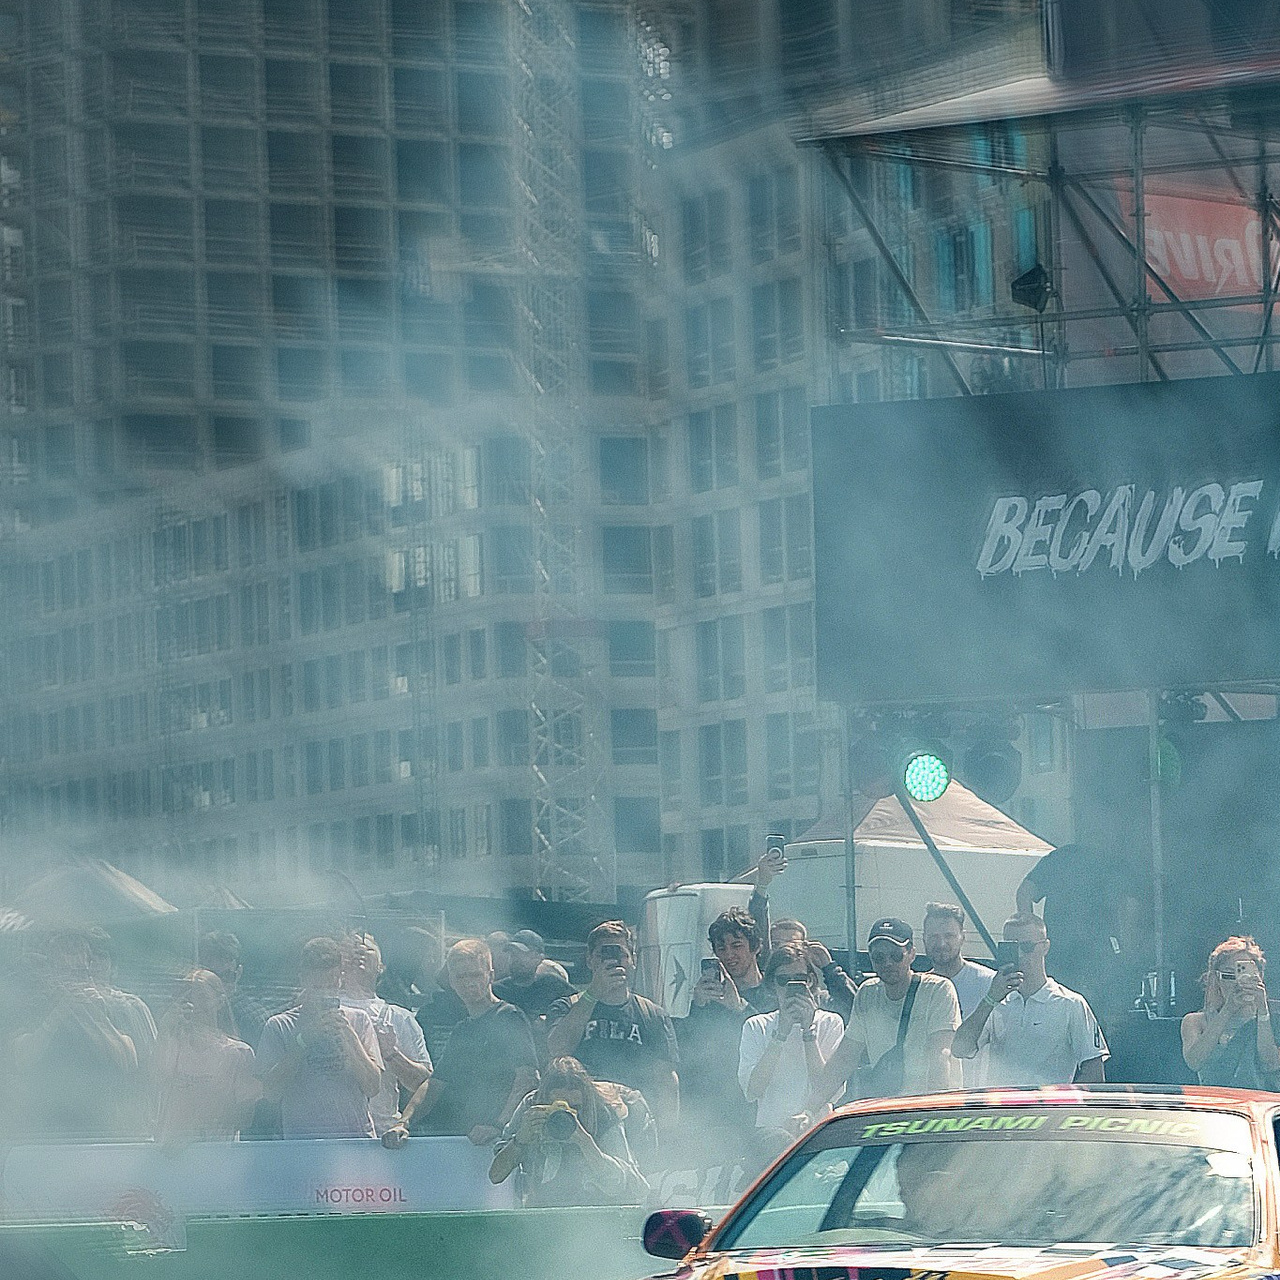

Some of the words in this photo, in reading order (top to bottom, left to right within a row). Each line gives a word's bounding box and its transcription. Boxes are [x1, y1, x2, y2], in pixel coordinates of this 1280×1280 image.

[975, 478, 1264, 580] BECAUSE
[861, 1114, 1048, 1139] TSUNAMI
[1059, 1115, 1199, 1138] PICNIC
[315, 1188, 375, 1203] MOTOR
[379, 1187, 408, 1203] OIL
